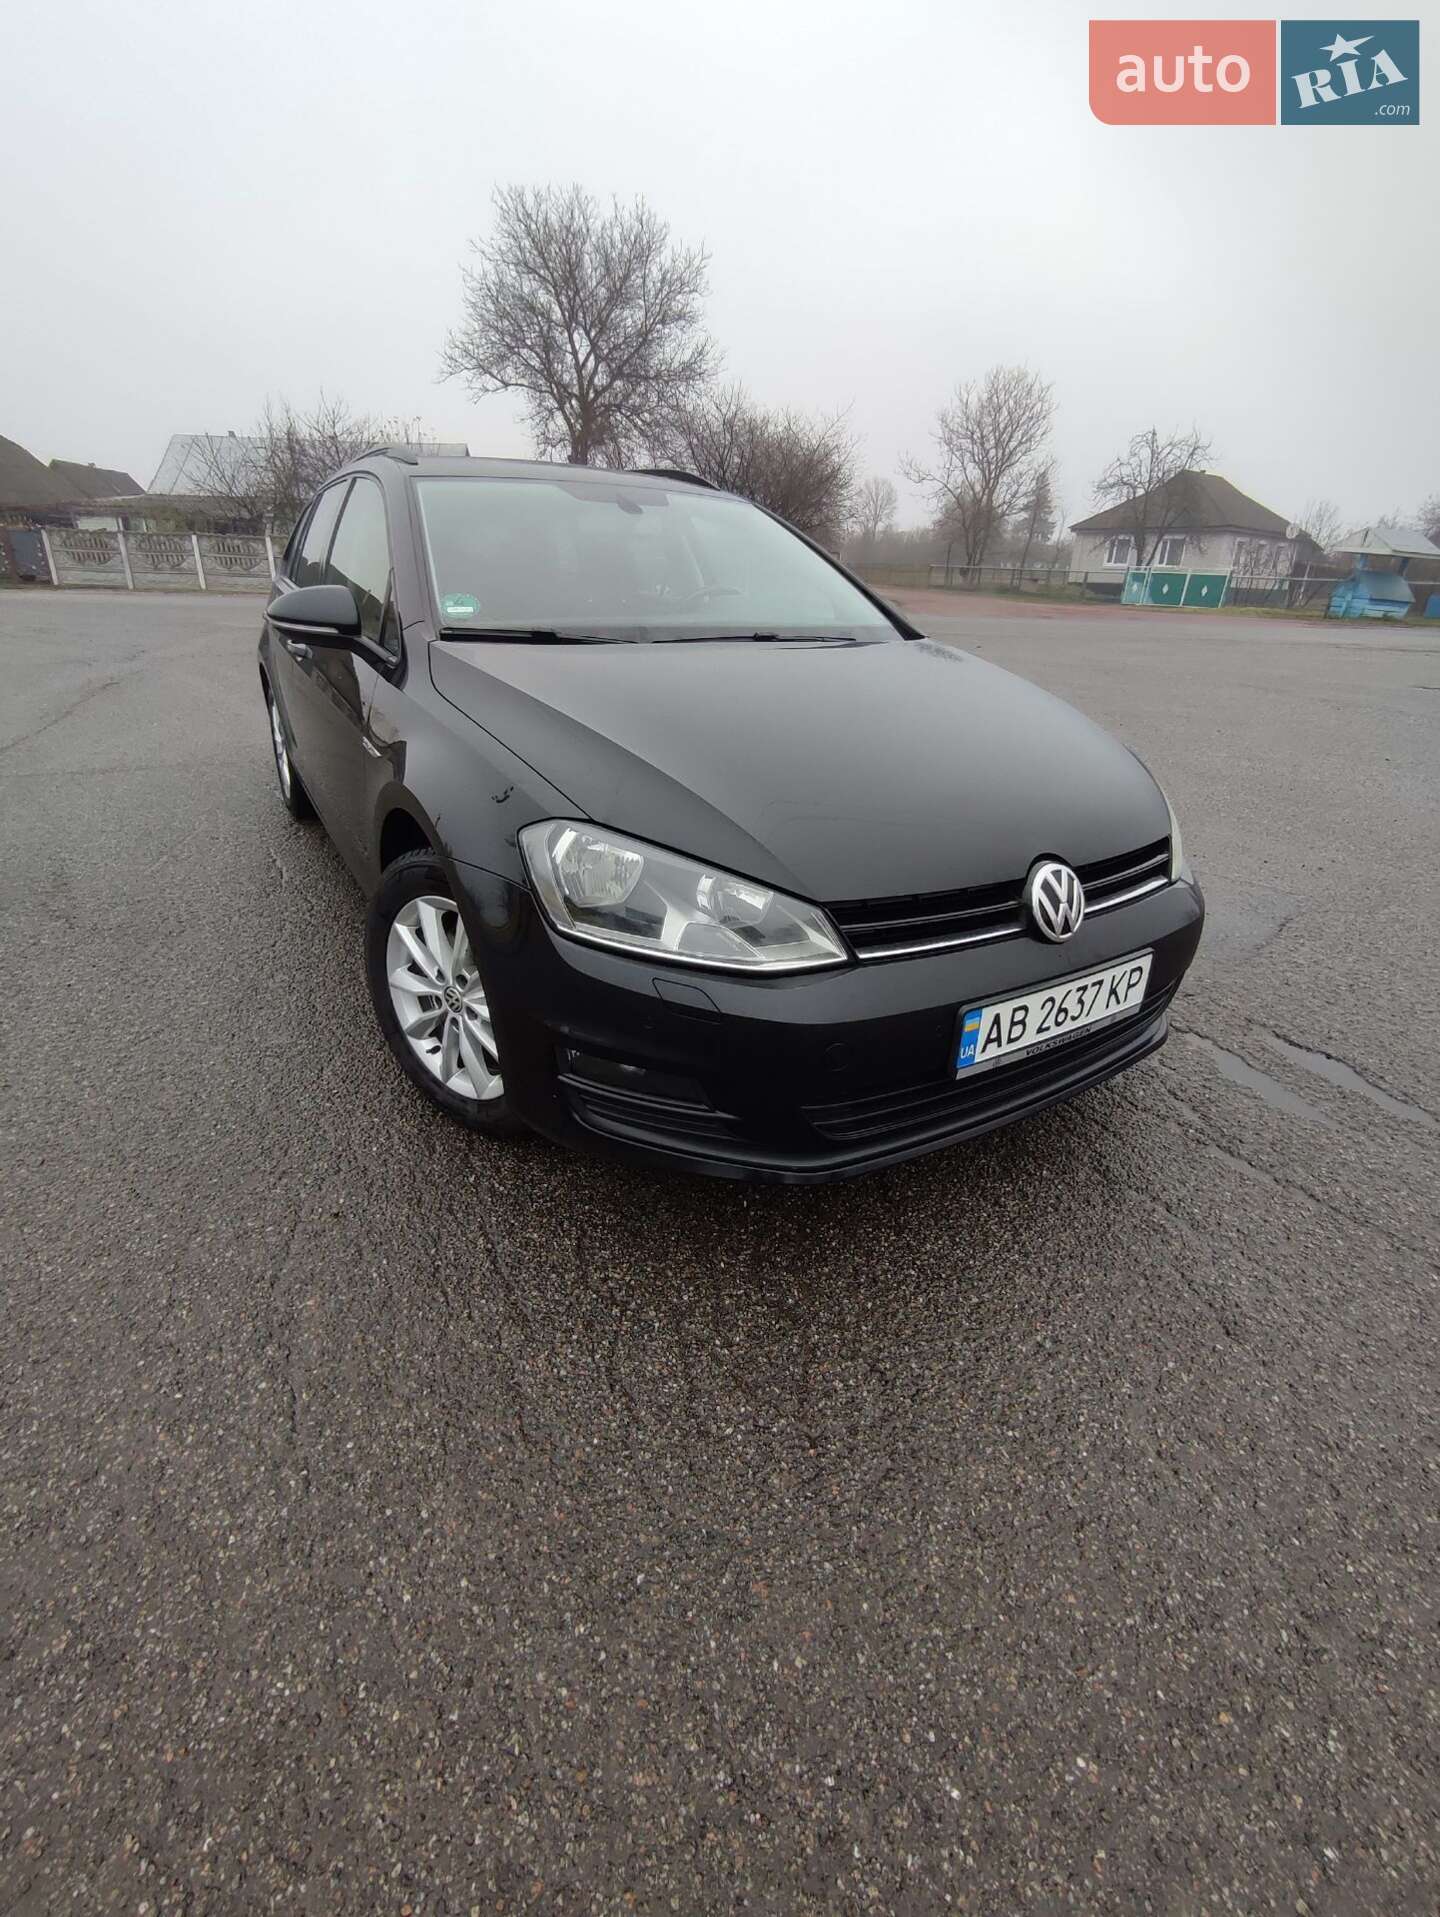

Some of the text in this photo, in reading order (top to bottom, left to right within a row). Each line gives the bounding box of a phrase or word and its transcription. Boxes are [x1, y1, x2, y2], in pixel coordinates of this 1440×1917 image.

[1031, 863, 1085, 942] VW
[980, 966, 1143, 1053] AB 2637 KP
[960, 1044, 975, 1059] UA
